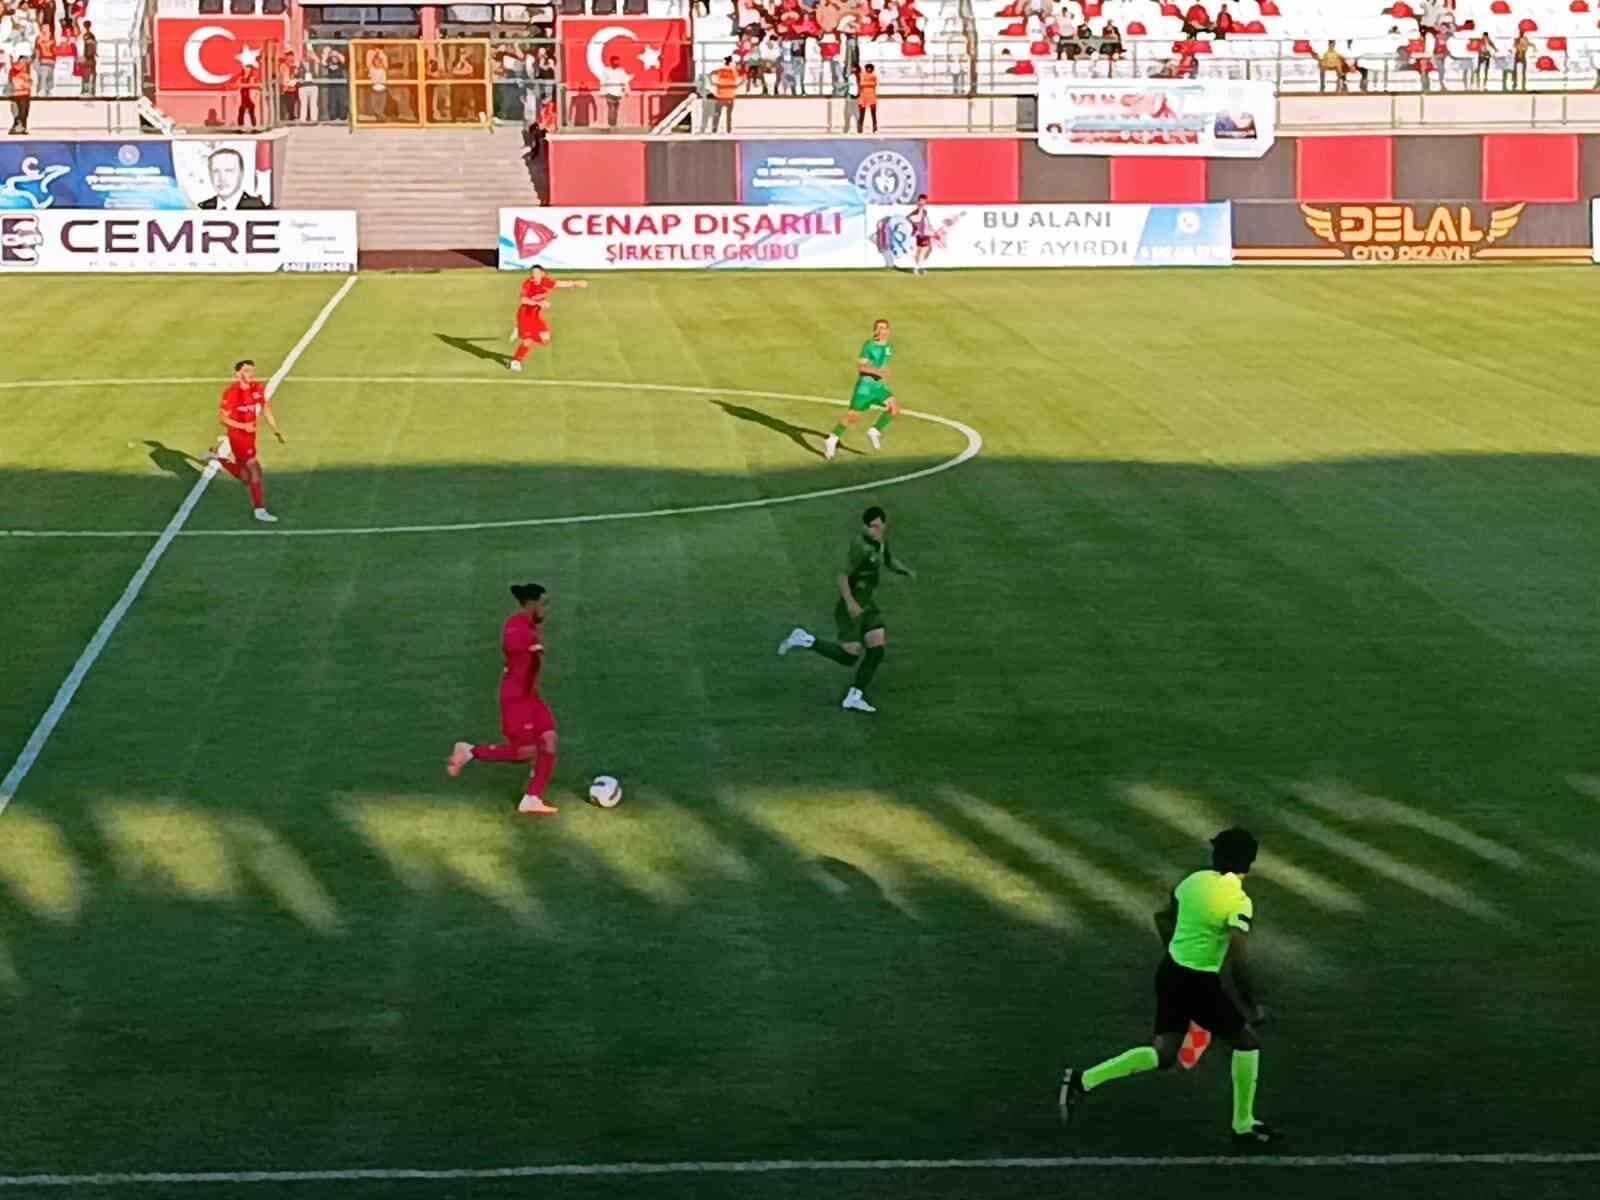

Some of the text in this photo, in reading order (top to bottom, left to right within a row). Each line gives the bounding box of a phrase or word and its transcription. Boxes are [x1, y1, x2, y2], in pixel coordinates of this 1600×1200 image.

[562, 213, 681, 236] CENAP
[983, 211, 1112, 228] BU ALANI
[1340, 206, 1484, 242] DELAL
[60, 219, 280, 254] CEMRE
[973, 237, 1028, 256] SİZE
[1039, 239, 1127, 256] AYIRDI
[606, 241, 716, 264] ŞİRKETLER
[1352, 246, 1395, 260] OTO
